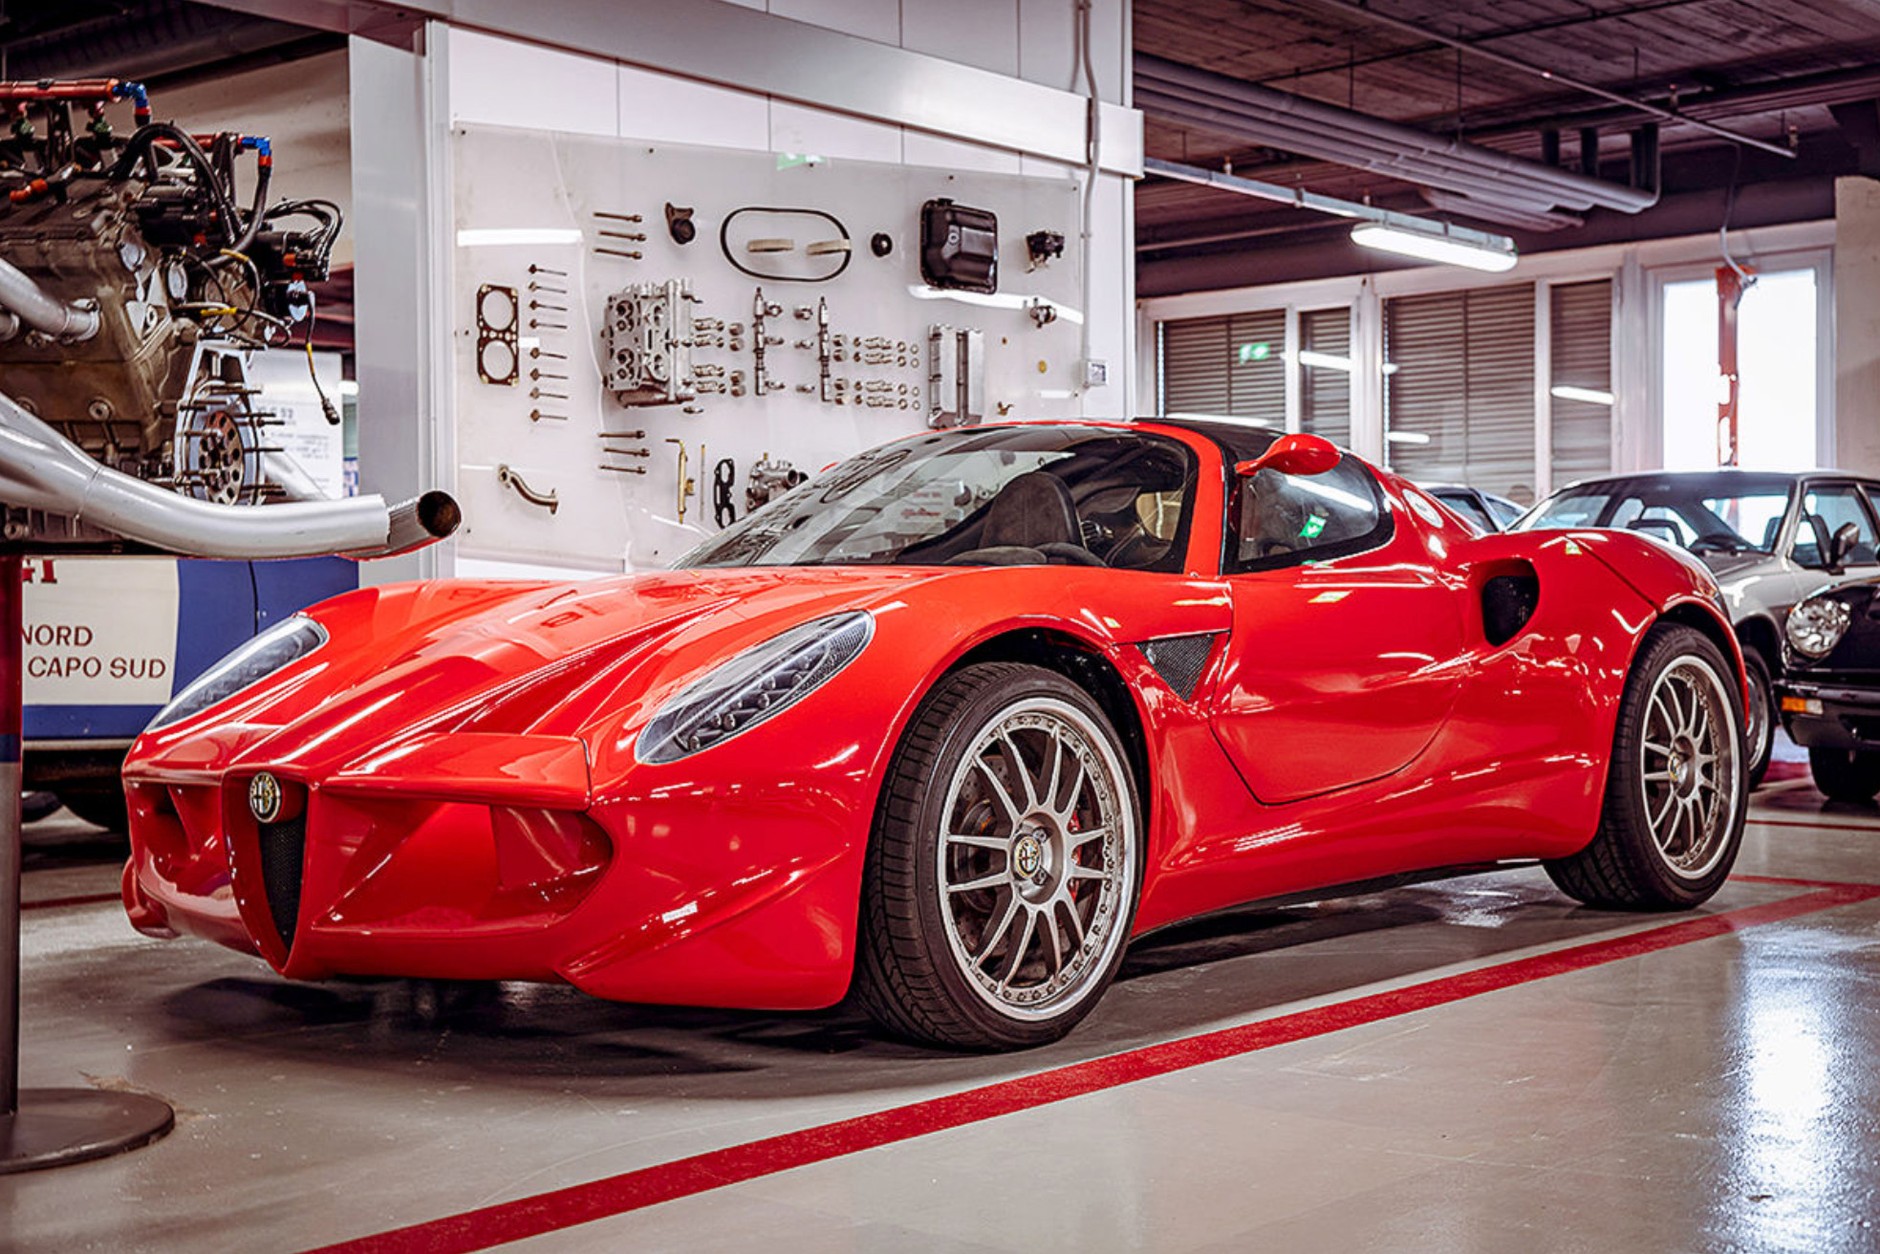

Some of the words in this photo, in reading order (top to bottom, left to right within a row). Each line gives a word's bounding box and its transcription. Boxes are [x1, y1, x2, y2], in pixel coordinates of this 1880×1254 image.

[22, 624, 93, 646] NORD
[28, 656, 101, 678] CAPO
[109, 657, 166, 678] SUD
